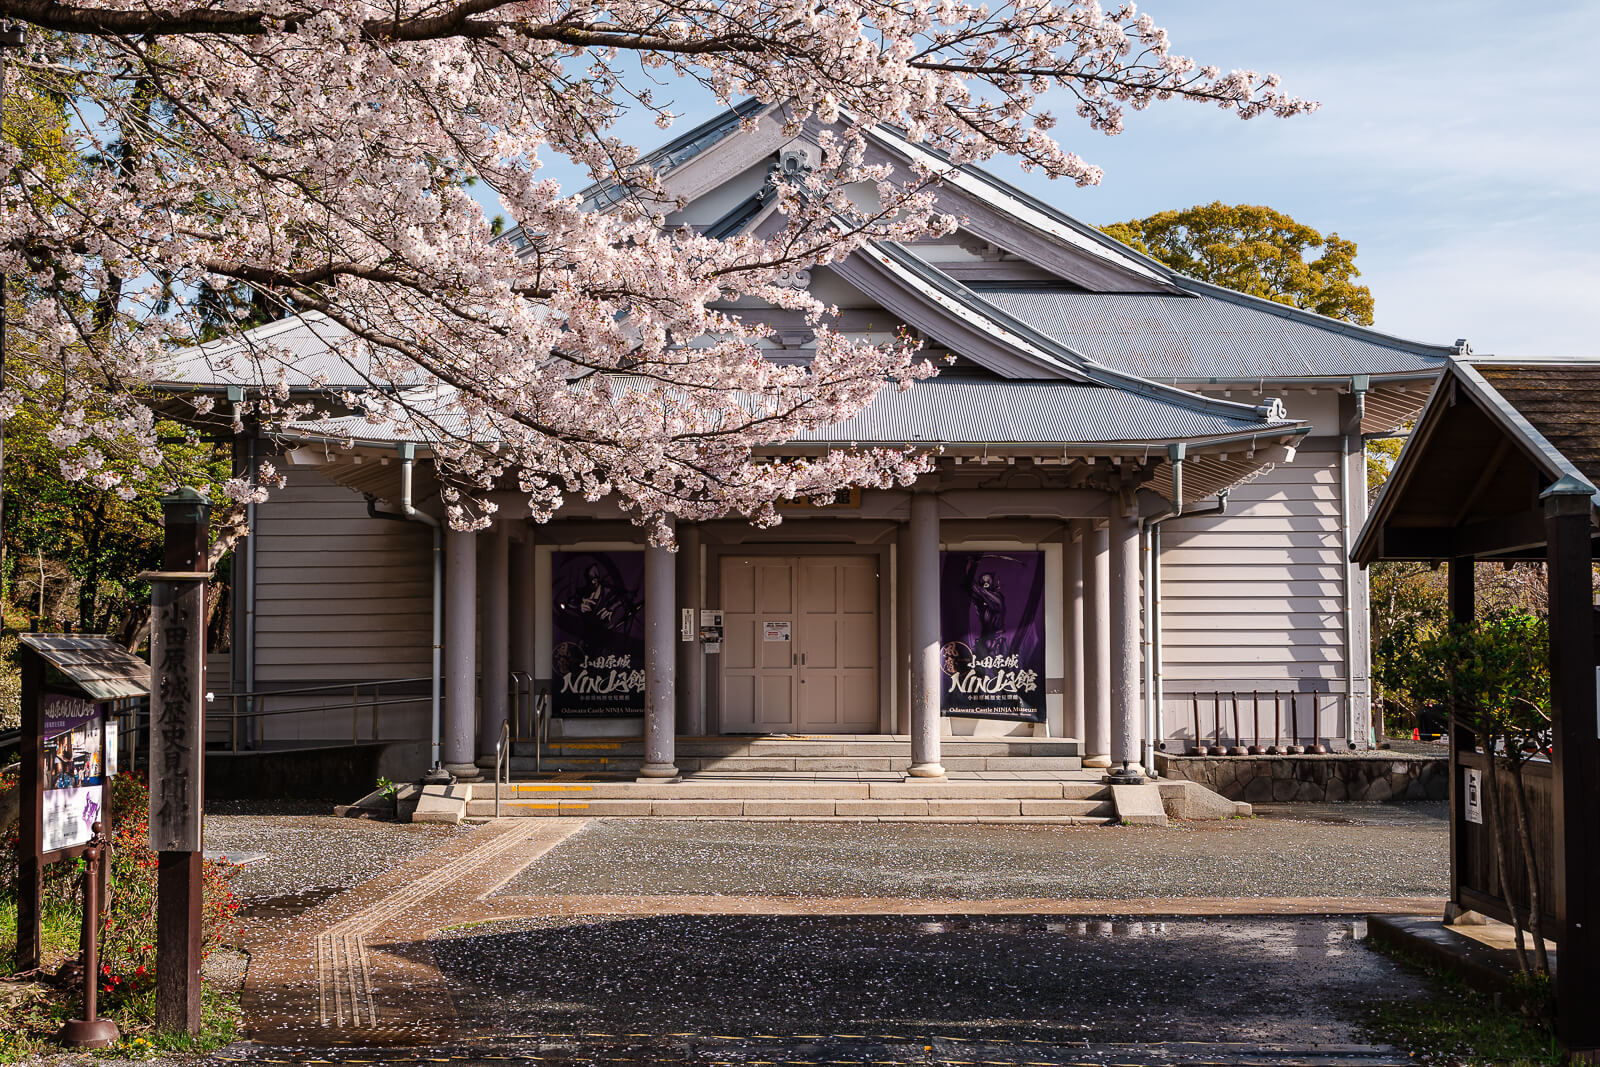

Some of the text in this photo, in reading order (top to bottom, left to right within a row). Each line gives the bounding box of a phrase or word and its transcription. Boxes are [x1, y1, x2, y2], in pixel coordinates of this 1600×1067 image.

[579, 654, 632, 669] 小田原城
[967, 653, 1020, 669] 小田原城
[948, 669, 1038, 694] NINJA館
